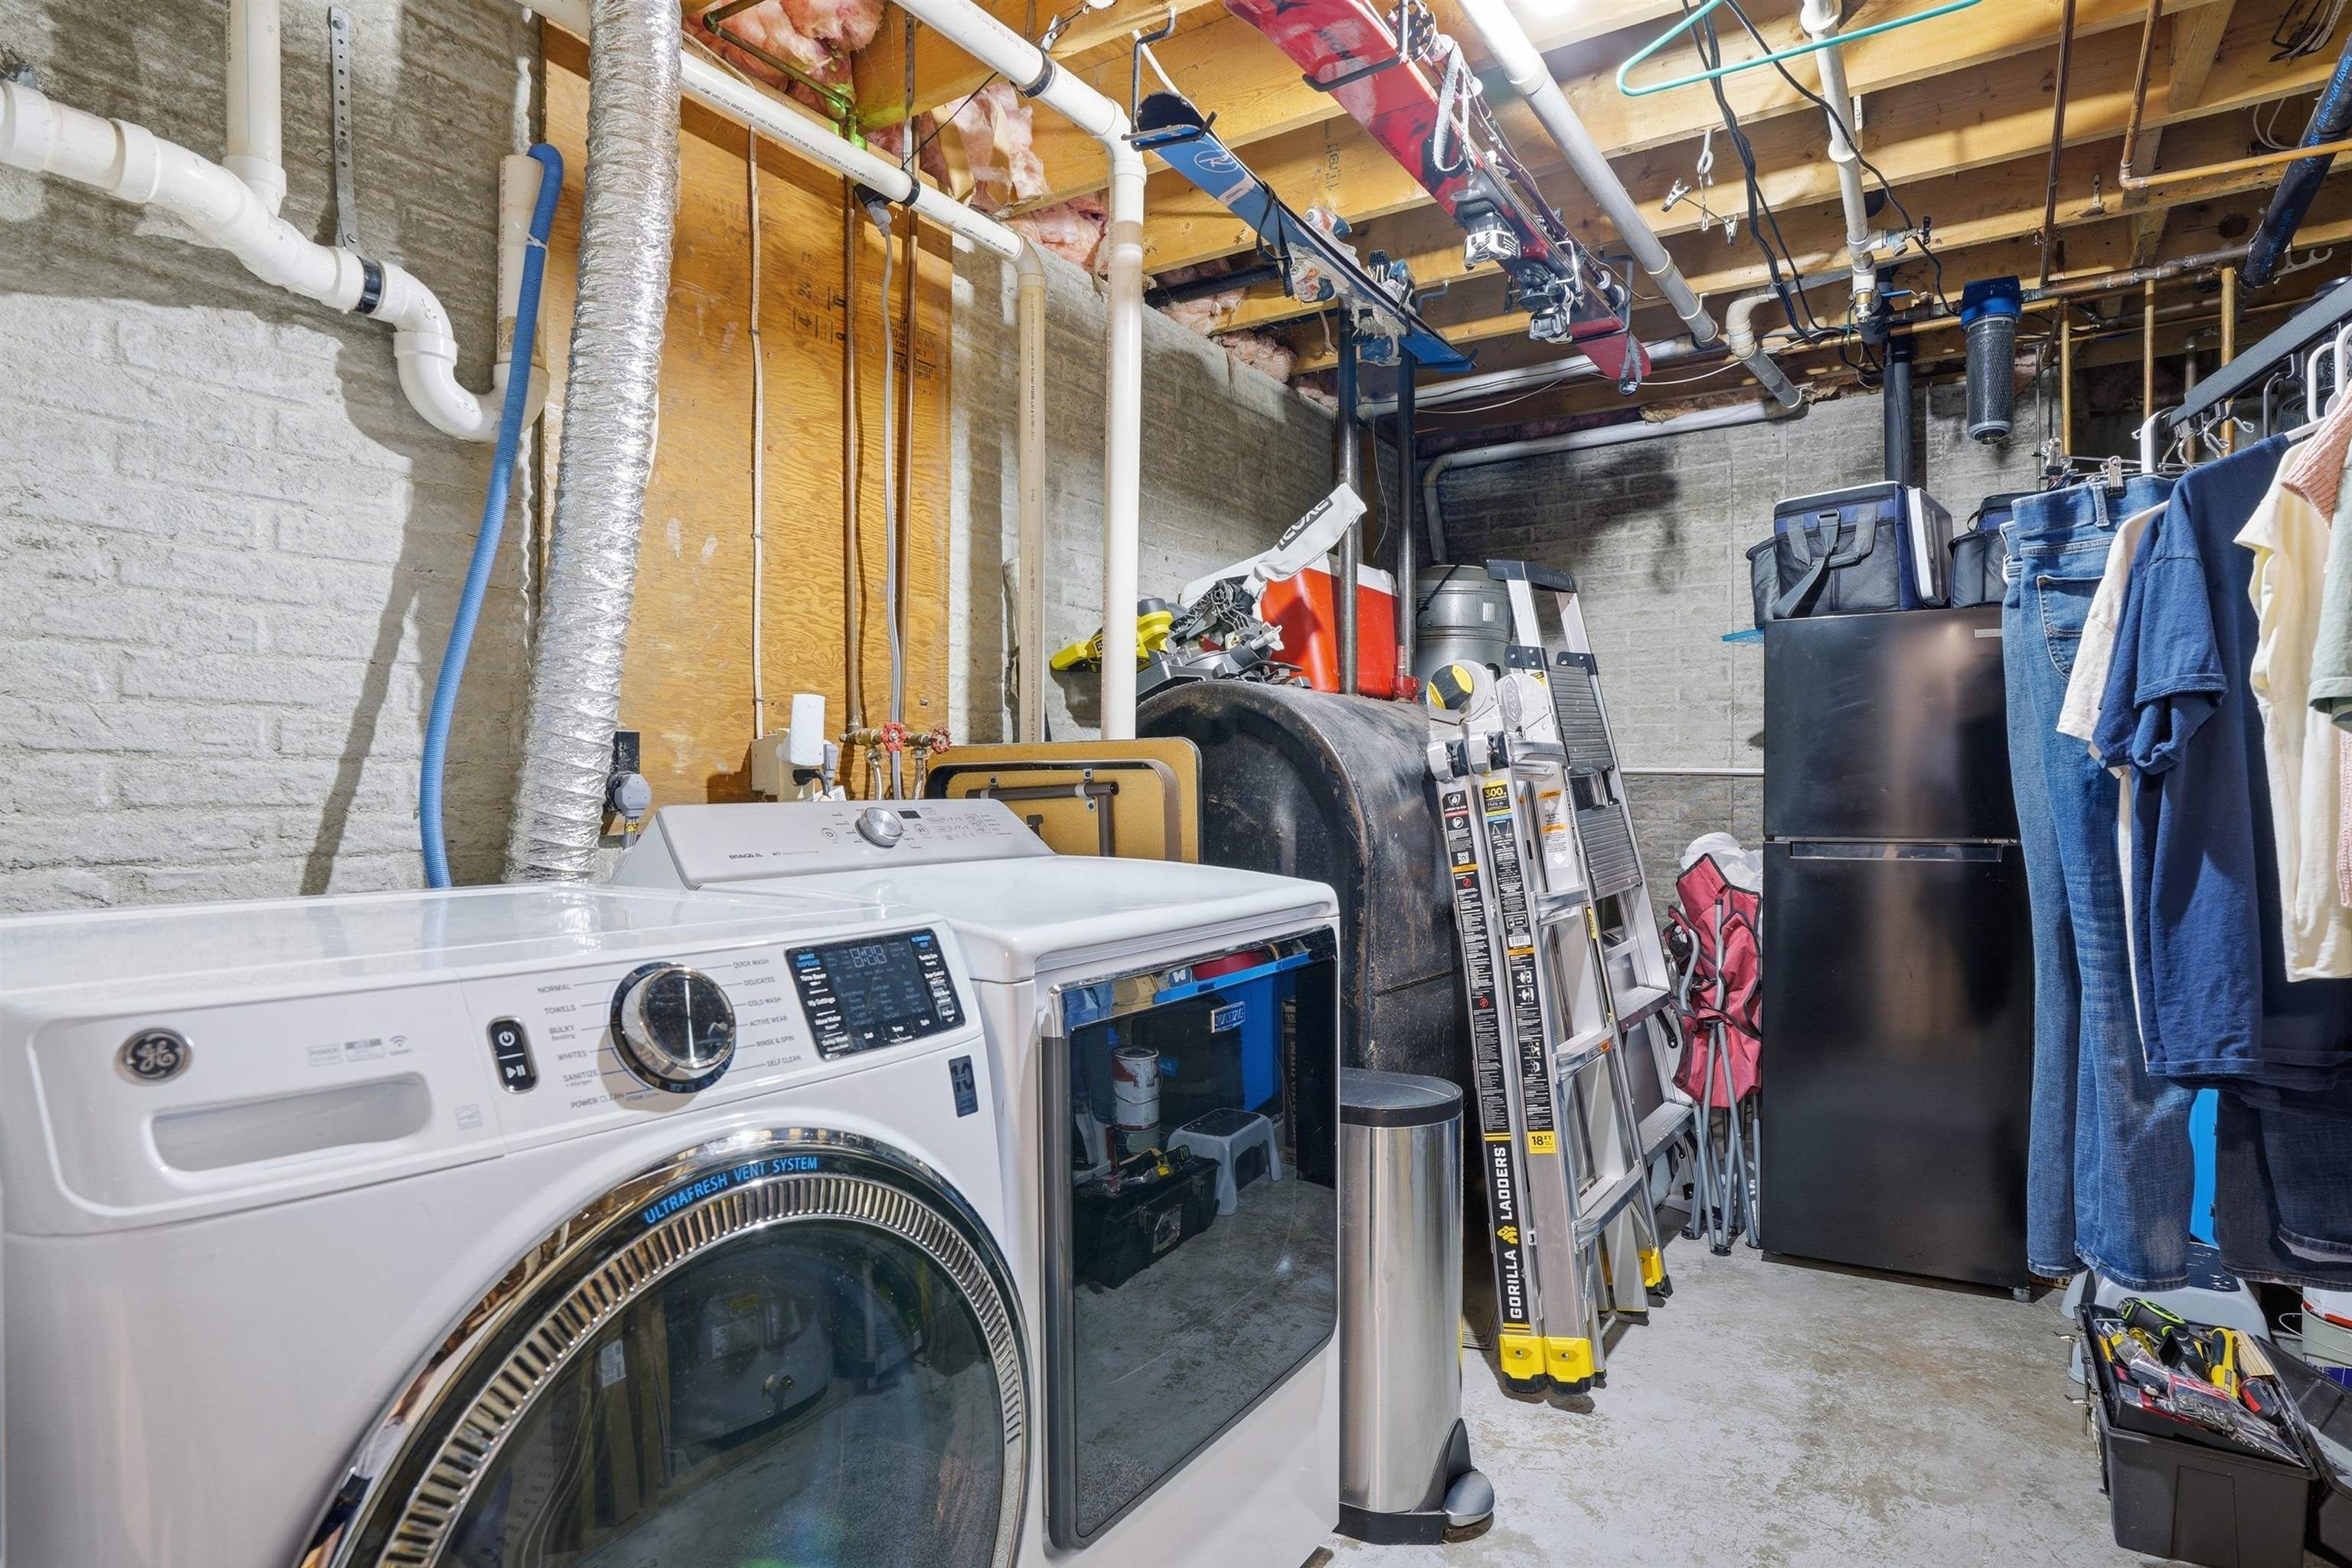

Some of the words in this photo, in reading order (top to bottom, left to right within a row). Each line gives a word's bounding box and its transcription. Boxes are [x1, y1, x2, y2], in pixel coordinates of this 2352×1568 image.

[743, 977, 776, 986] DELICATES
[537, 984, 571, 993] NORMAL
[766, 997, 782, 1005] WASH
[544, 1004, 577, 1014] TOWELS
[750, 1018, 770, 1027] ACTIVE
[549, 1024, 575, 1034] BULKY
[756, 1038, 775, 1047] RINSE
[557, 1050, 588, 1060] WHITES
[767, 1058, 782, 1067] SELF
[782, 1055, 802, 1064] CLEAN
[564, 1070, 599, 1082] SANITIZE
[570, 1096, 599, 1108] POWER
[599, 1093, 625, 1102] CLEAN
[1531, 1135, 1544, 1146] 18
[1494, 1147, 1513, 1221] LADDERS
[644, 1173, 727, 1223] ULTRAFRESH
[733, 1163, 766, 1182] VENT
[773, 1157, 818, 1174] SYSTEM
[1504, 1249, 1523, 1320] GORILLA
